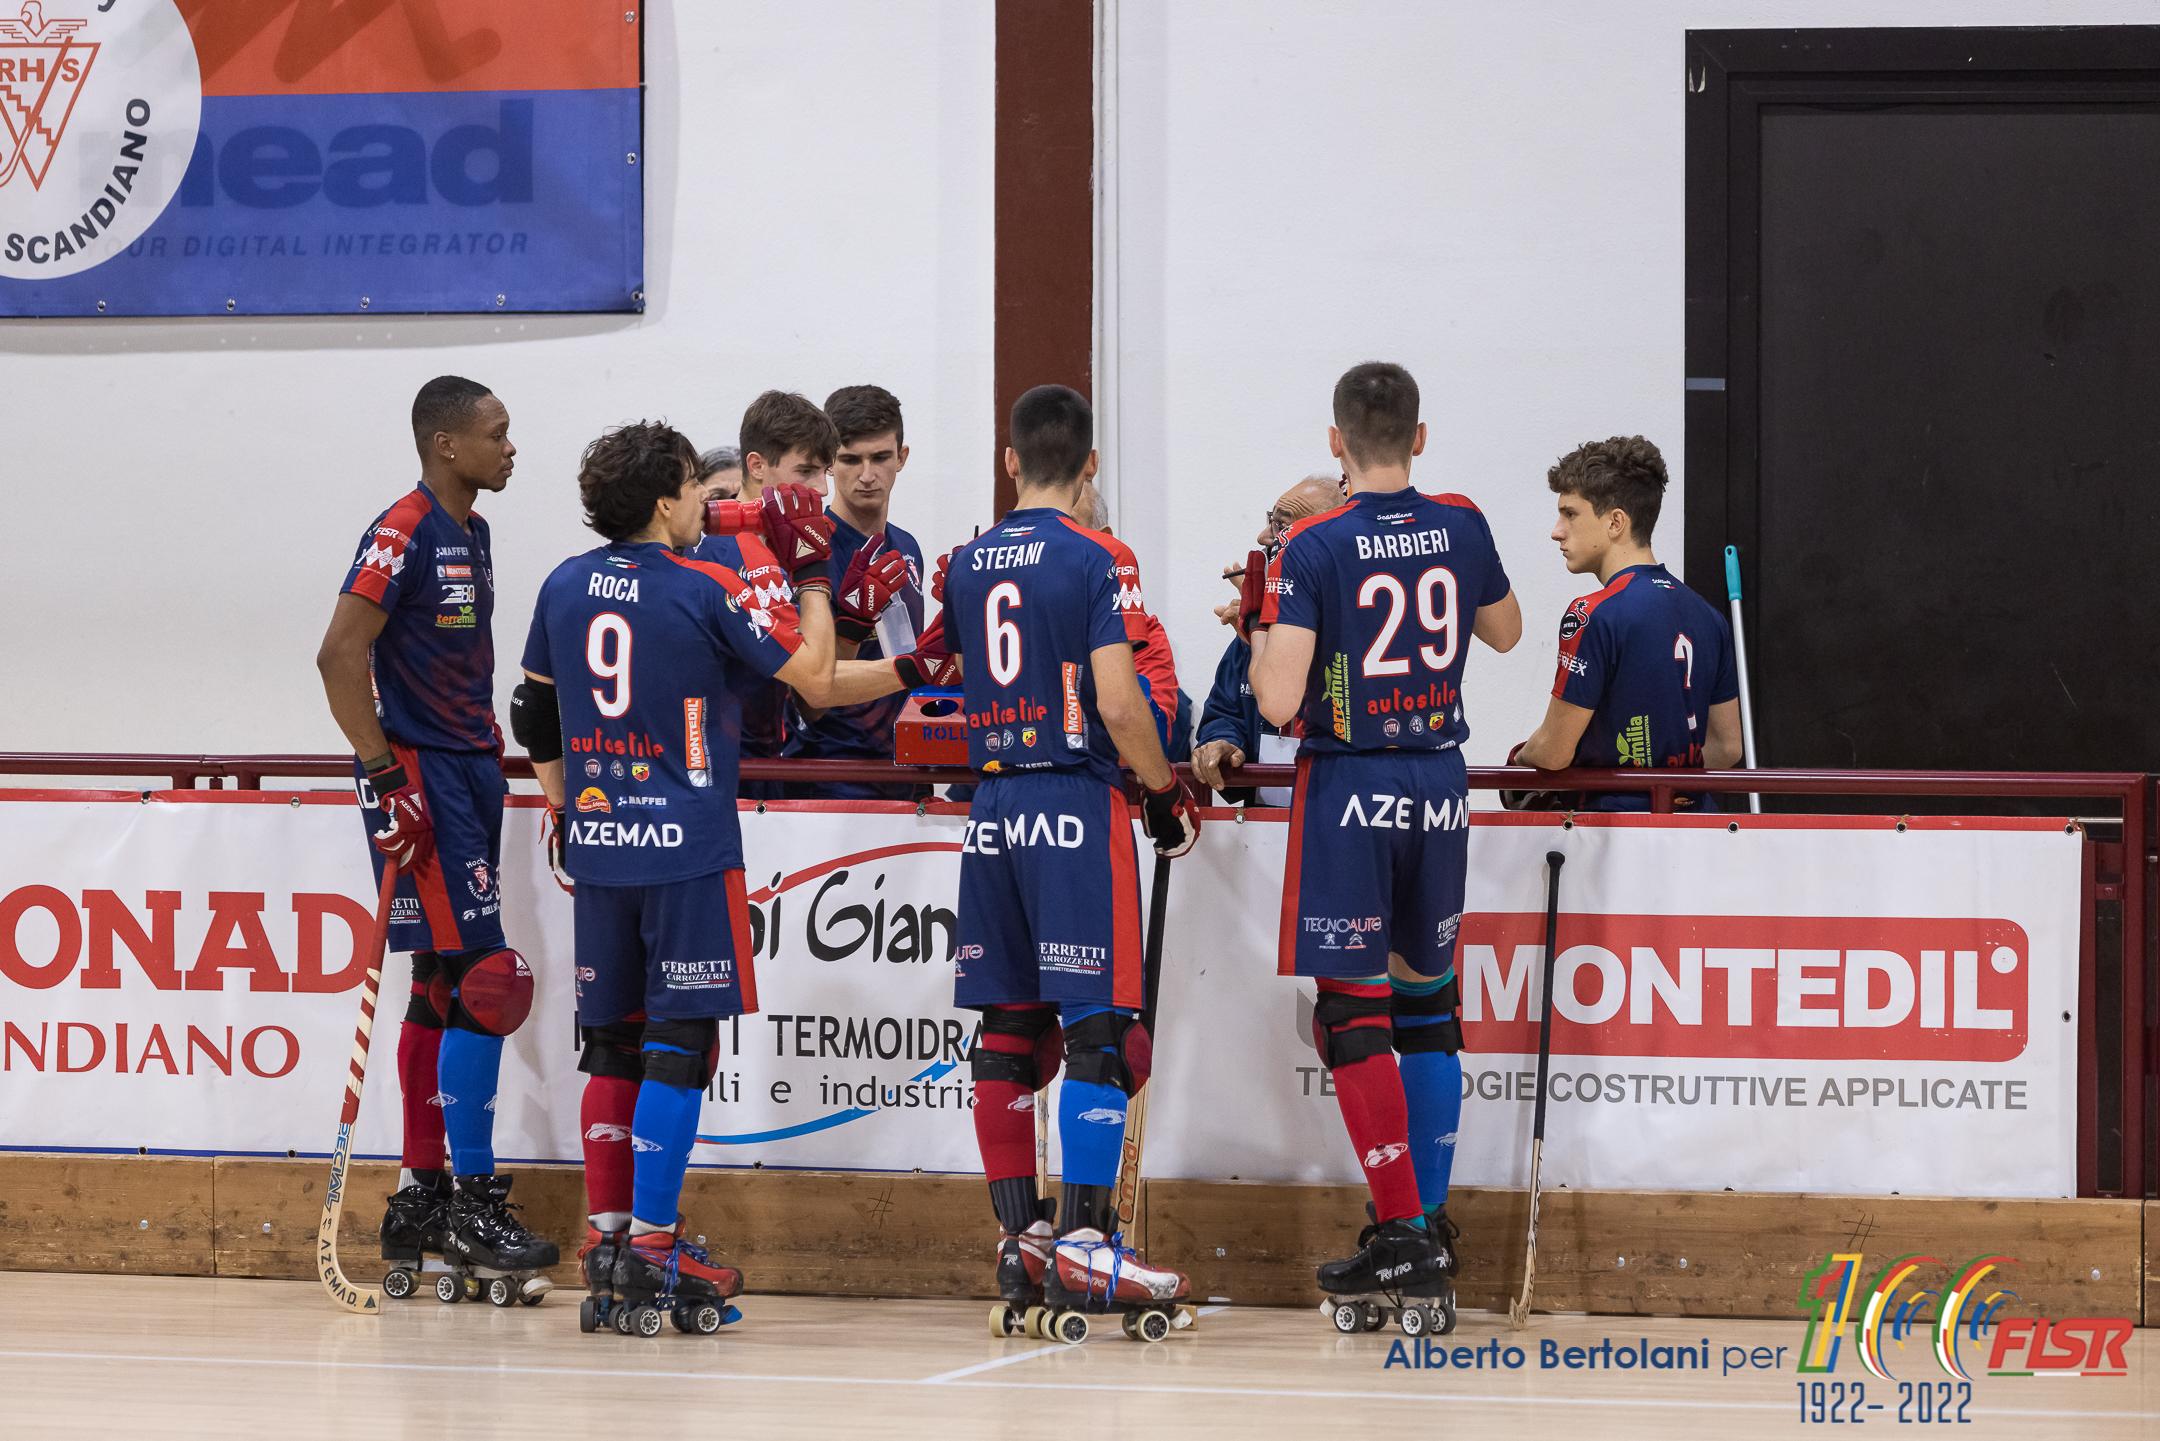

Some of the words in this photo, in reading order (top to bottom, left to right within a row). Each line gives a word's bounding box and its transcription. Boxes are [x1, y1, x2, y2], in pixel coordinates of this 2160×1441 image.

[5, 98, 151, 265] SCANDIANO
[183, 235, 307, 259] DIGITAL
[323, 232, 529, 257] INTEGRATOR
[971, 541, 1046, 572] STEFANI
[1355, 527, 1450, 560] BARBIERI
[588, 572, 640, 603] ROCA
[747, 565, 770, 581] FISR
[984, 580, 1022, 688] 6
[1357, 565, 1460, 679] 29
[585, 611, 633, 719] 9
[1367, 681, 1456, 716] autostile
[570, 727, 664, 758] autostile
[686, 699, 703, 768] MONTEDIL
[568, 820, 684, 848] AZEMAD
[661, 959, 732, 974] FERRETTI
[1039, 942, 1106, 960] ERRETTI
[666, 972, 730, 982] CARROZZERIA
[1463, 944, 2014, 1030] MONTEDIL
[4, 1021, 301, 1079] NDIANO
[770, 1080, 792, 1104] e
[1549, 1072, 1807, 1107] COSTRUTTIVE
[1817, 1077, 2028, 1110] APPLICATE
